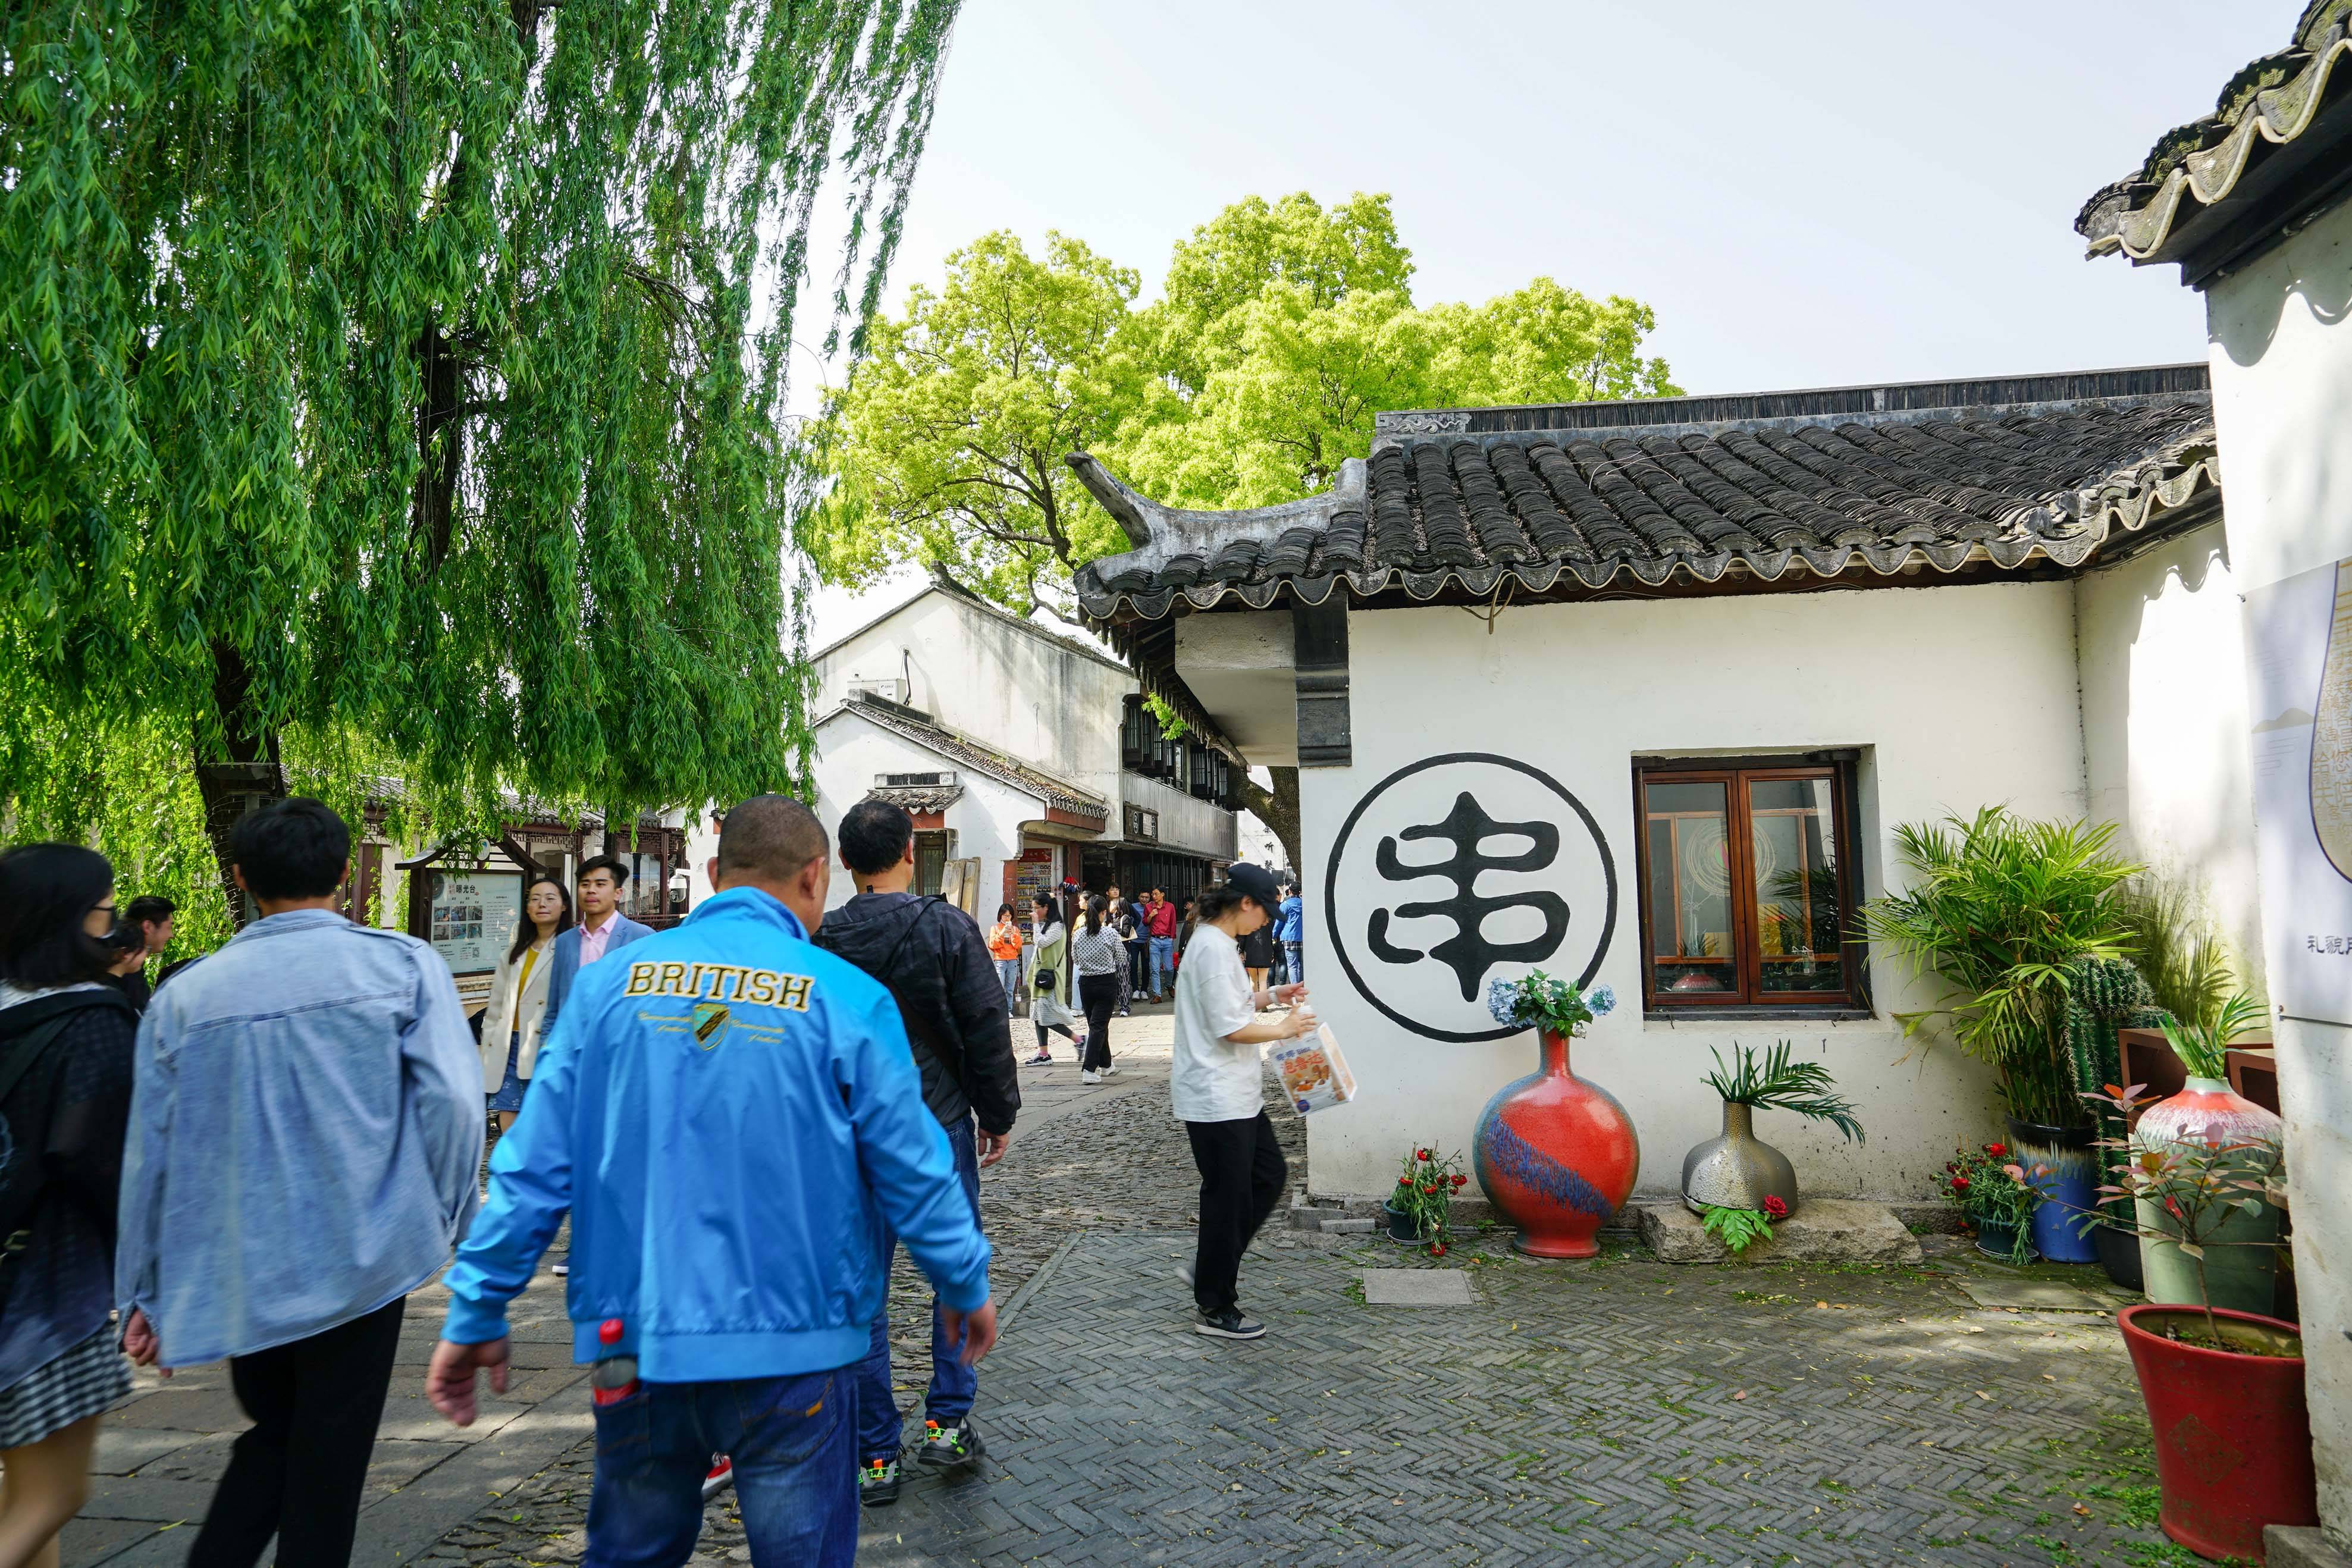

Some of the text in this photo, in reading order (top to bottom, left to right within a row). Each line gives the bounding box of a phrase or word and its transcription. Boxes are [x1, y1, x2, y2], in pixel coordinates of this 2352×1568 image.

[456, 885, 475, 893] 曝光台
[1367, 791, 1570, 1002] 串
[625, 962, 814, 1012] BRITISH
